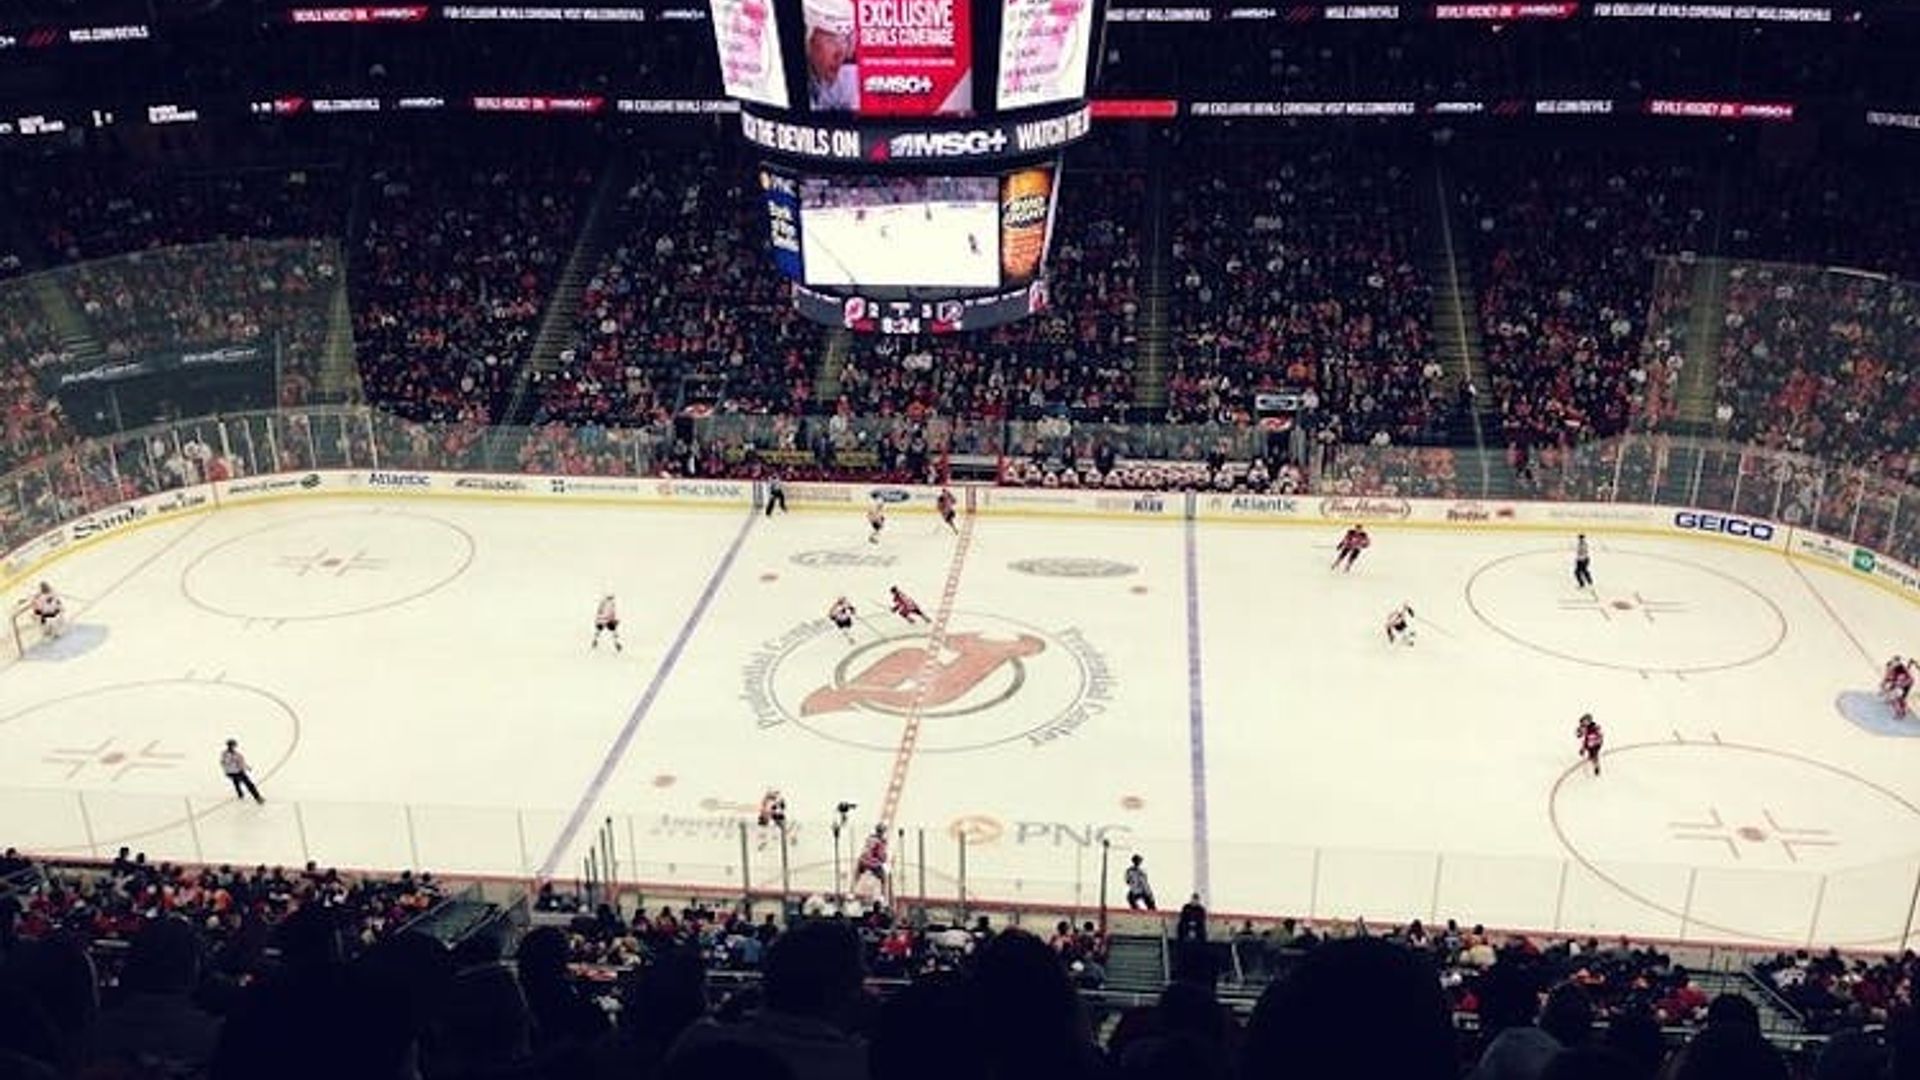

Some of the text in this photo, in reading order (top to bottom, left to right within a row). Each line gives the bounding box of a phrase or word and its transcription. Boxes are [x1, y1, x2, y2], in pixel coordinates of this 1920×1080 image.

[860, 0, 955, 28] EXCLUSIVE
[861, 29, 956, 47] DEVILS COVERAGE
[865, 76, 932, 94] MSG+
[778, 123, 830, 156] DEVILS
[831, 129, 860, 157] ON
[892, 129, 1007, 157] MSG+
[1016, 116, 1066, 151] WATCH
[368, 471, 431, 488] Atlantic
[1231, 497, 1295, 512] Atlantic
[1674, 511, 1774, 542] GEICO
[1016, 820, 1130, 850] PNC
